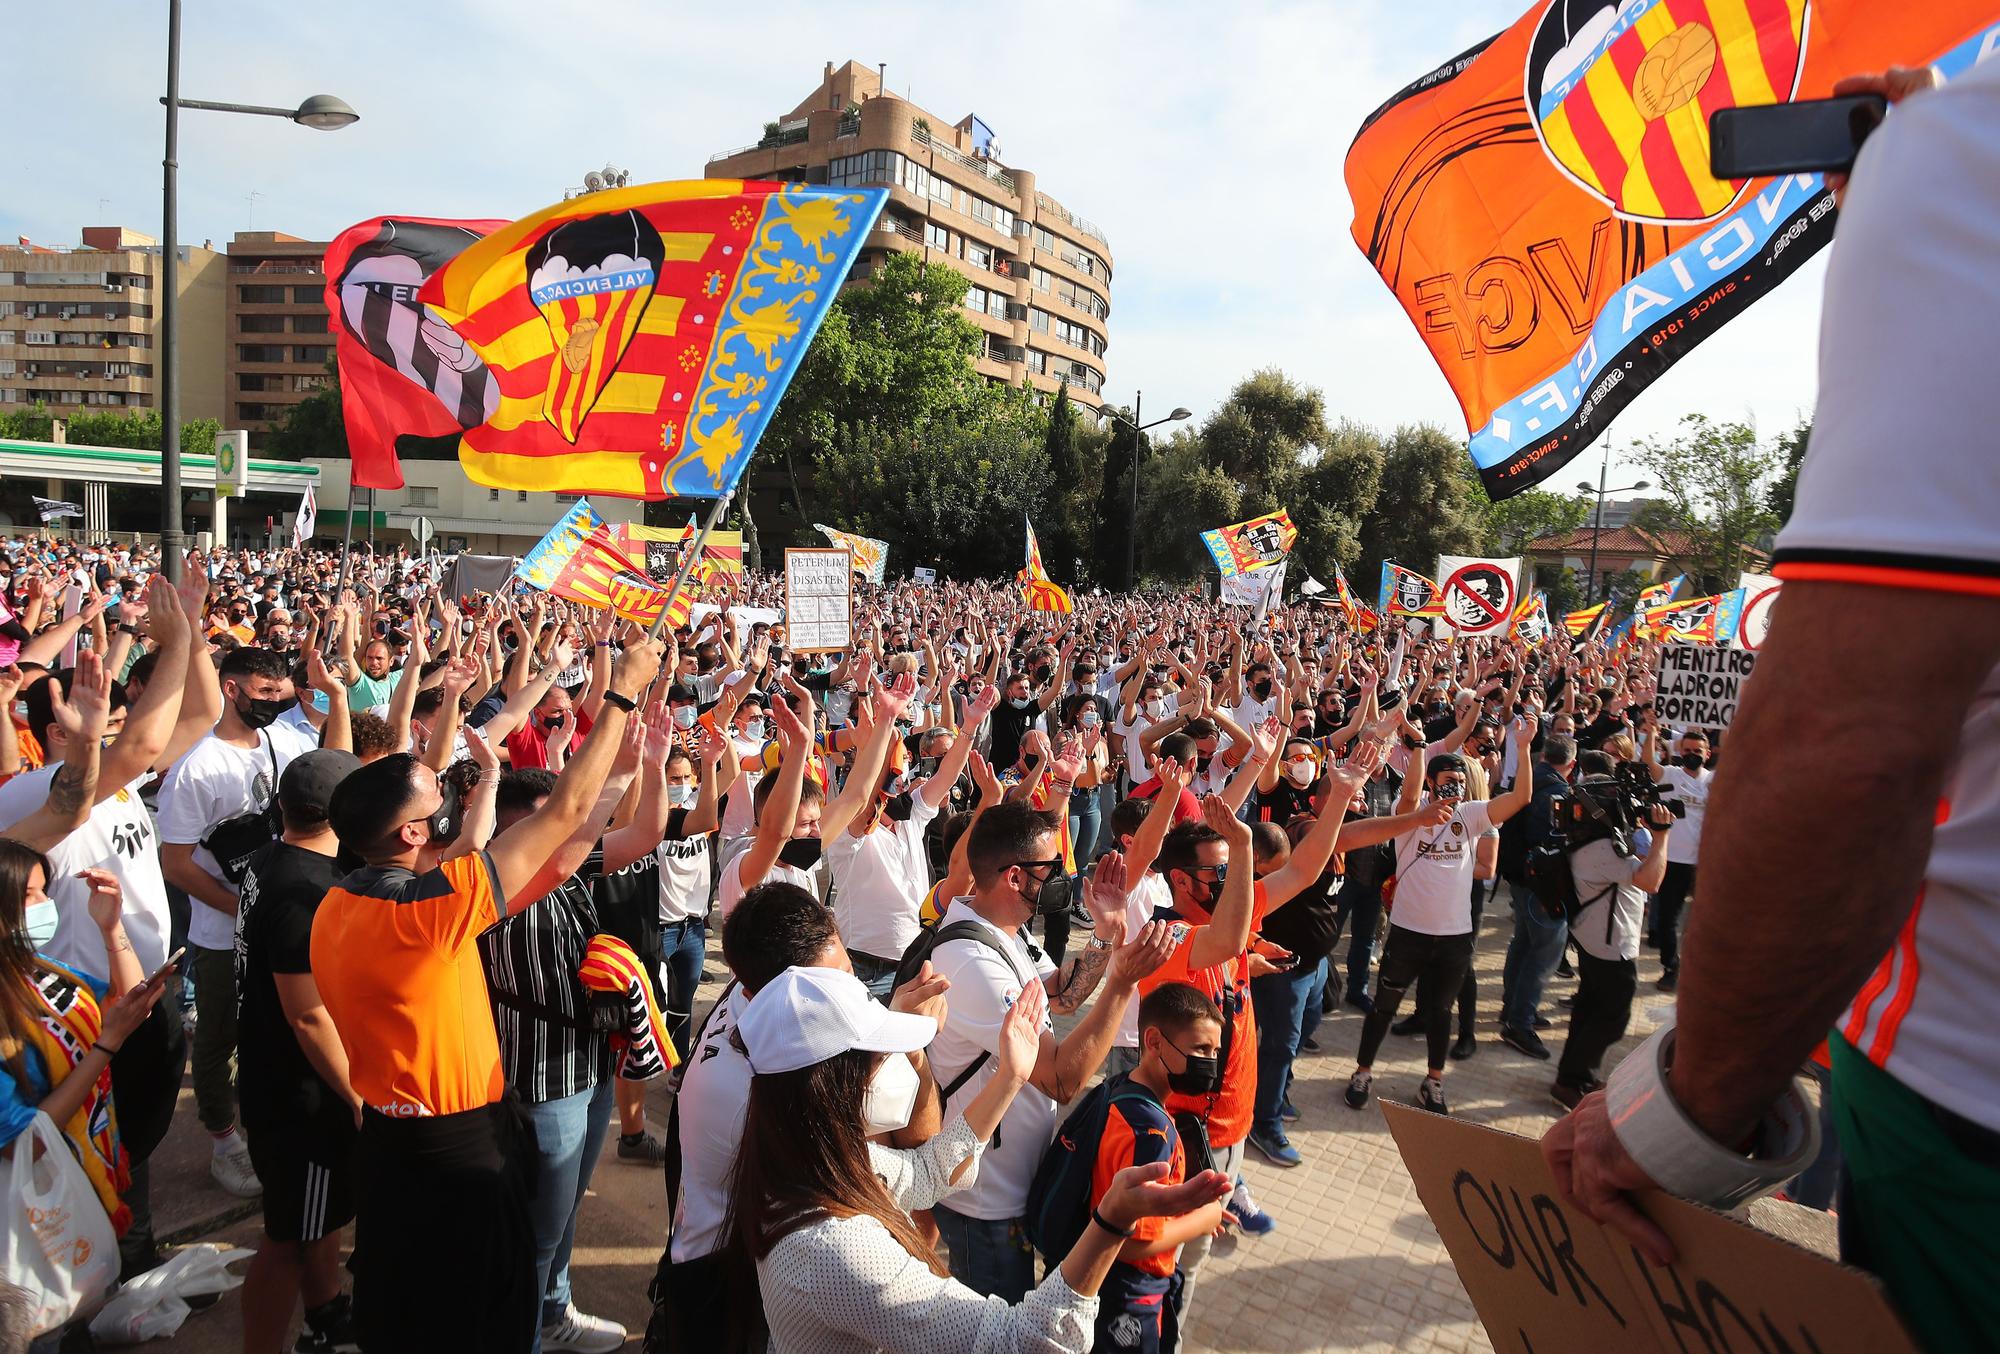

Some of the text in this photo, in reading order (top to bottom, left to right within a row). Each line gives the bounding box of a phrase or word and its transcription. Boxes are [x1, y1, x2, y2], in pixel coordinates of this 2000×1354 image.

[1250, 531, 1278, 544] YOMUS
[791, 557, 845, 568] PETER LIM
[793, 575, 844, 585] DISASTER
[1244, 572, 1261, 580] OUR
[1656, 671, 1738, 700] LADRON
[1453, 1168, 1626, 1329] OUR
